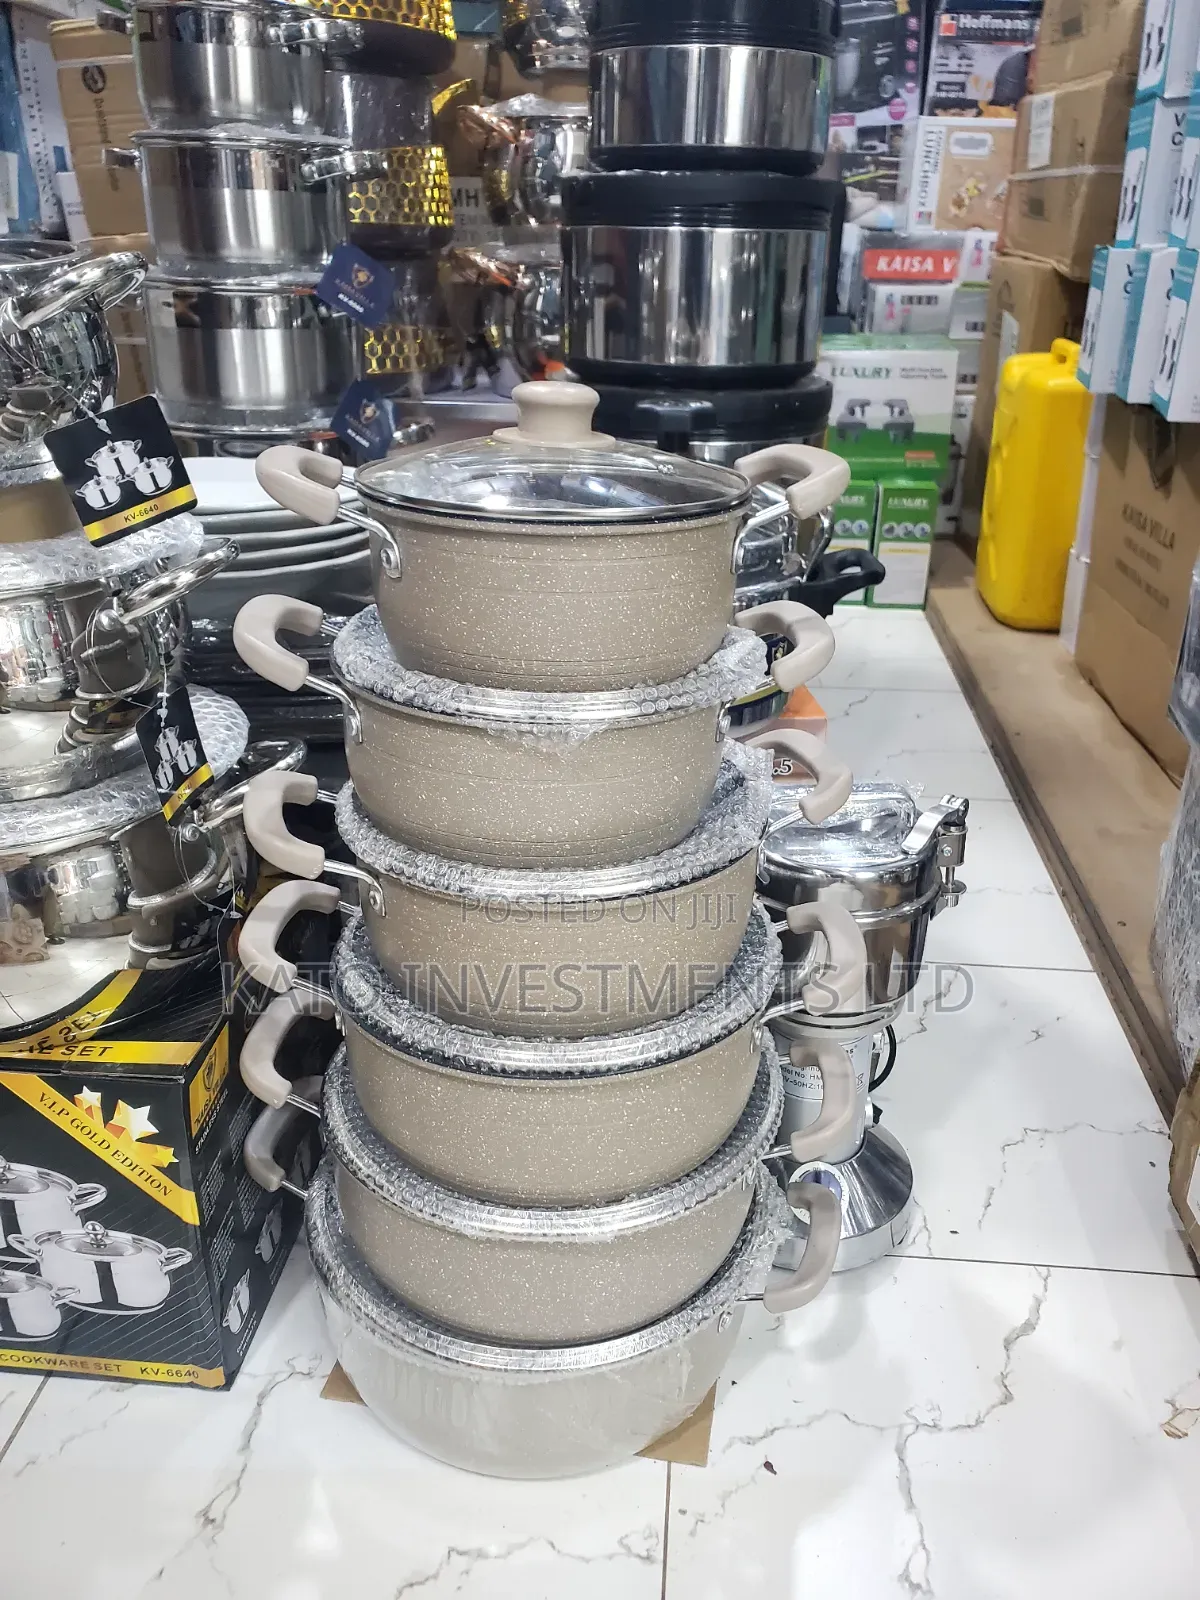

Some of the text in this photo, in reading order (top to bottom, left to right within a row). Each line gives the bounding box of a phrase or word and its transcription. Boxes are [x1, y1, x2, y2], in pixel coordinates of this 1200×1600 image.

[959, 14, 1031, 29] Hoffmans
[876, 254, 935, 273] KAISA
[123, 503, 159, 523] KV-6640
[60, 1045, 113, 1057] SET
[38, 1091, 70, 1118] V.I.P
[70, 1117, 112, 1151] GOLD
[111, 1149, 173, 1198] EDITION
[0, 1352, 199, 1380] COOKWARE SET KV-6640
